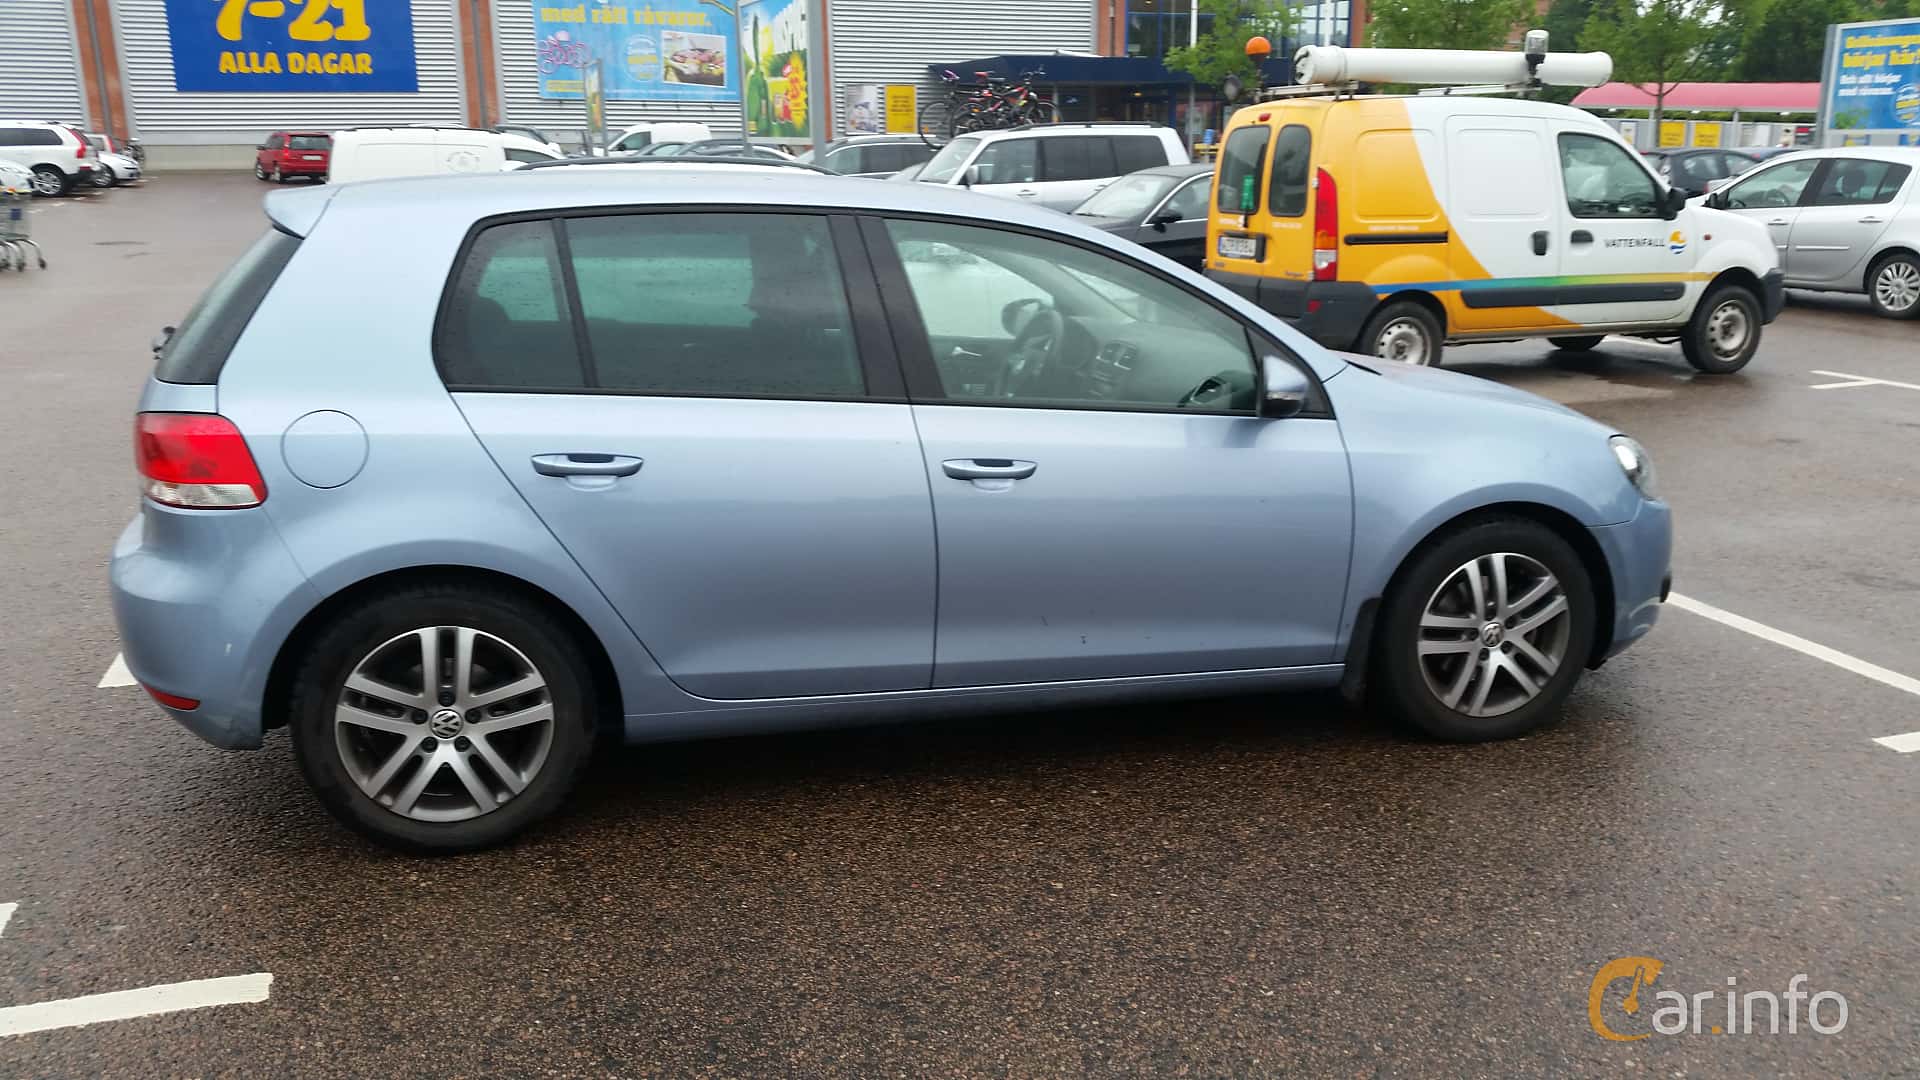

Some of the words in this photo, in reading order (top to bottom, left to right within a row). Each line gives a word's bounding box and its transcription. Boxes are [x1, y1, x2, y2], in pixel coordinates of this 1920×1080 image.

[540, 4, 586, 24] med
[218, 51, 283, 74] ALLA
[286, 52, 373, 75] DAGAR
[1604, 238, 1665, 248] VATTENFALL
